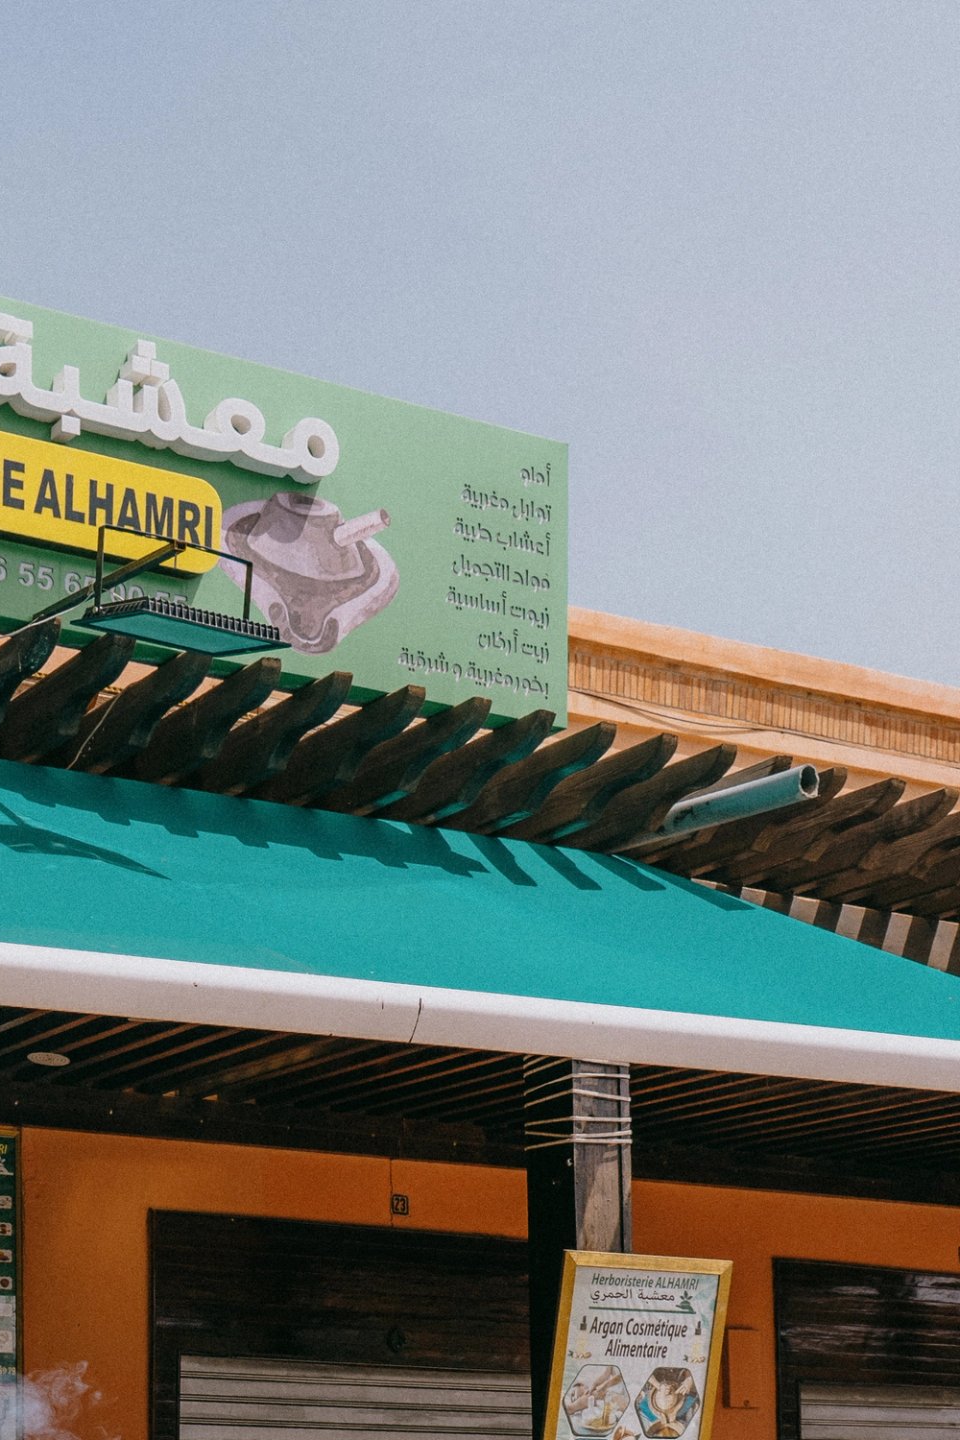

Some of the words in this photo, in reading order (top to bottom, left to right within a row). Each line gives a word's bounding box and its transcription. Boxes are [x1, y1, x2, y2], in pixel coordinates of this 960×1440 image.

[33, 468, 214, 550] ALHAMRI
[461, 483, 509, 511] مغربية
[512, 498, 552, 524] توابل
[453, 517, 492, 543] طبية
[496, 530, 551, 556] أعشاب
[18, 563, 55, 591] 55
[451, 554, 510, 581] التجميل
[446, 586, 507, 615] أساسية
[510, 606, 549, 630] زيوت
[398, 647, 449, 674] شرقية
[521, 642, 549, 664] زيت
[591, 1273, 655, 1288] Herboristerie
[655, 1276, 700, 1290] ALHAMRI
[590, 1288, 633, 1304] الحمري
[637, 1288, 675, 1304] معشبة
[589, 1316, 624, 1339] Argan
[625, 1318, 688, 1342] Cosmétique
[604, 1339, 668, 1359] Alimentaire
